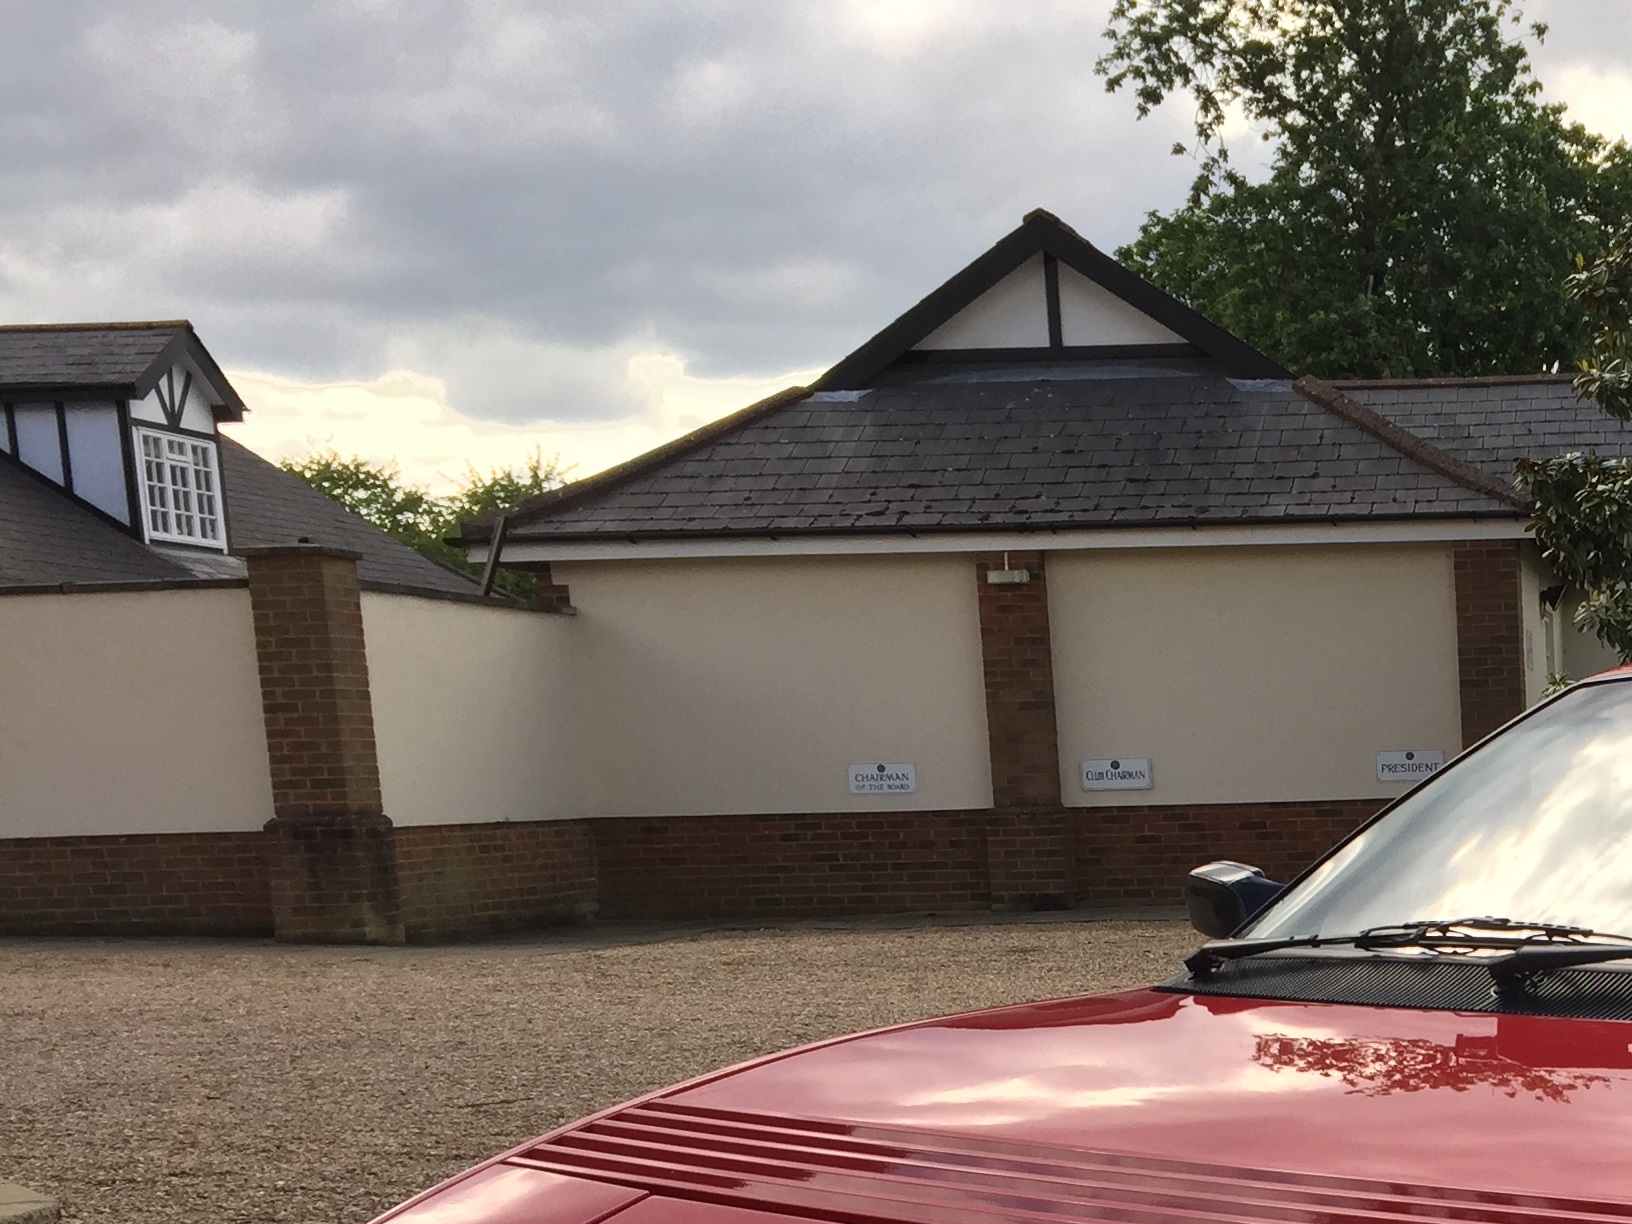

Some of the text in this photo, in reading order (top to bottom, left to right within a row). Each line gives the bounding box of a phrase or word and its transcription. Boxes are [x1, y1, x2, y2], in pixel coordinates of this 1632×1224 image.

[1381, 763, 1440, 773] PRESIDENT
[854, 773, 909, 782] CHAIRMAN
[1105, 769, 1146, 780] CHAIRMAN
[887, 783, 910, 791] BOARD
